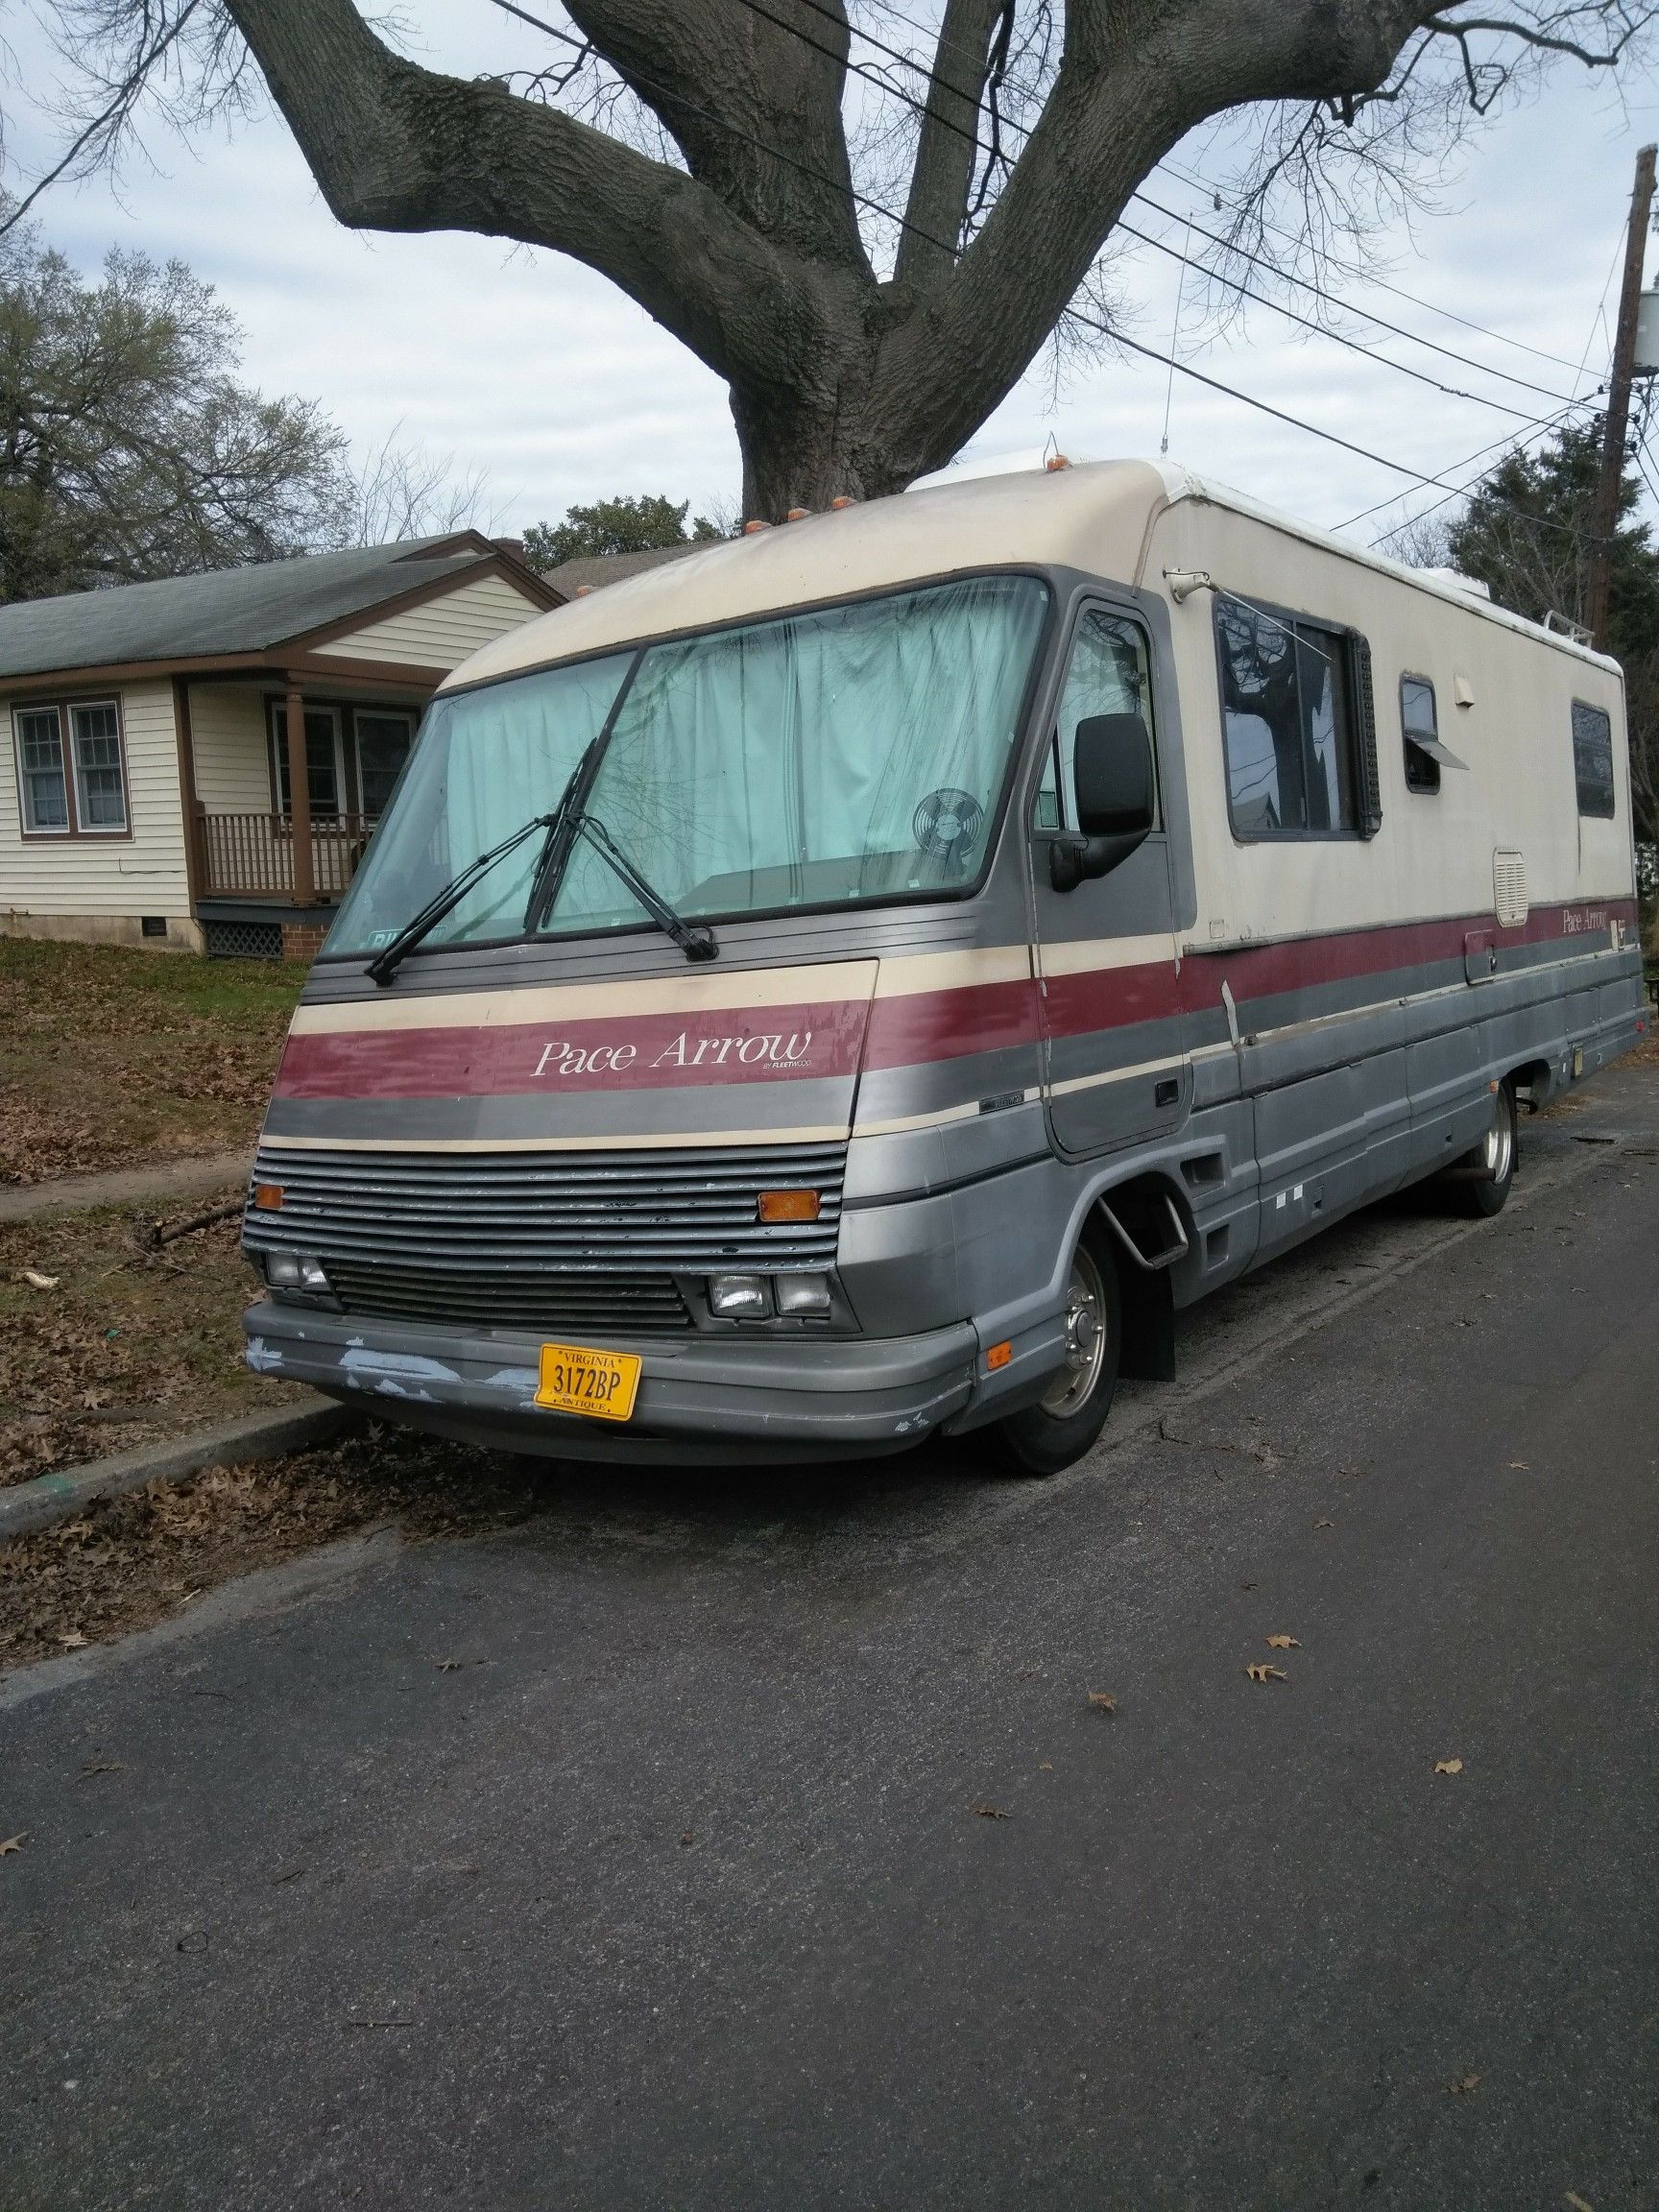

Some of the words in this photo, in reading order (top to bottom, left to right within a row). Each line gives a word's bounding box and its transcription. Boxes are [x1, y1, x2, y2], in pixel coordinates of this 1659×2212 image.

[1563, 910, 1582, 933] Pace
[530, 1042, 637, 1077] Pace
[649, 1031, 812, 1068] Arrow
[773, 1059, 812, 1069] FLEETWOOD
[565, 1352, 615, 1368] VIRGINIA
[554, 1364, 621, 1401] 3172BP
[560, 1397, 607, 1411] ANTIQUE
